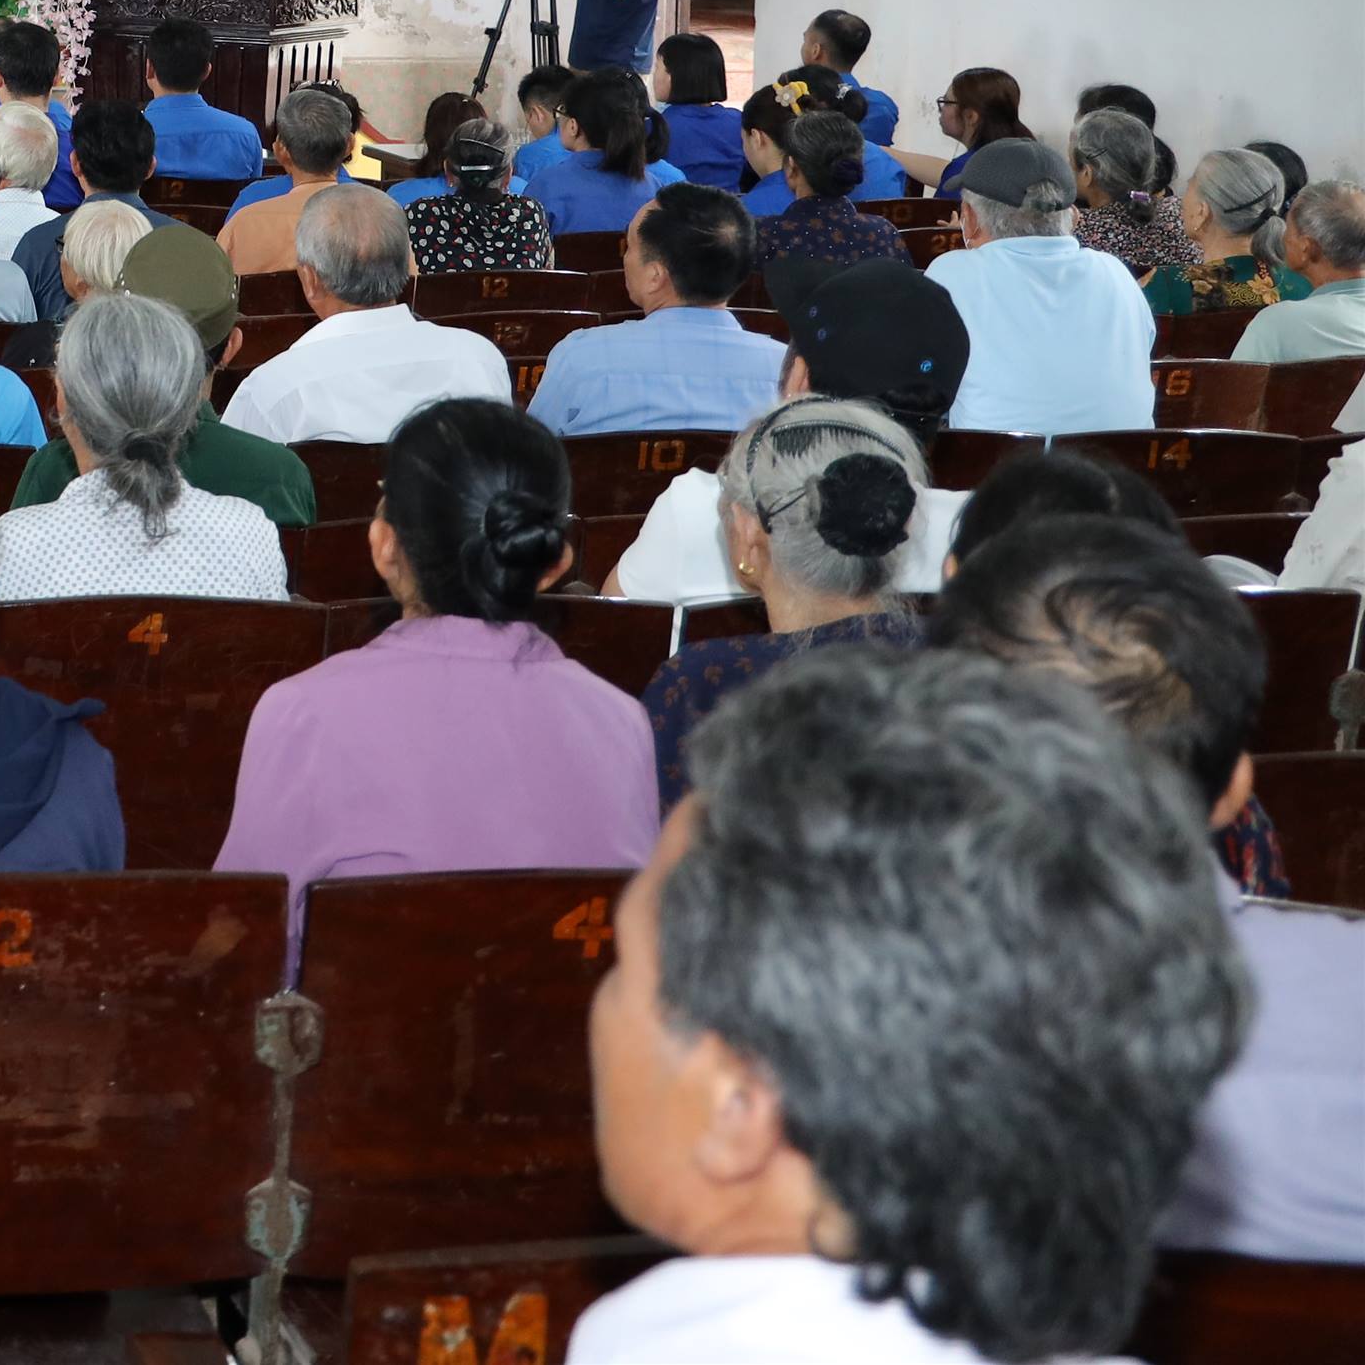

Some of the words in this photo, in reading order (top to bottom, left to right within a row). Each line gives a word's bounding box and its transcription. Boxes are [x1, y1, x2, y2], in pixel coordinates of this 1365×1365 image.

[638, 440, 685, 471] 10
[1148, 438, 1191, 470] 14
[128, 612, 168, 656] 4
[553, 897, 613, 958] 4
